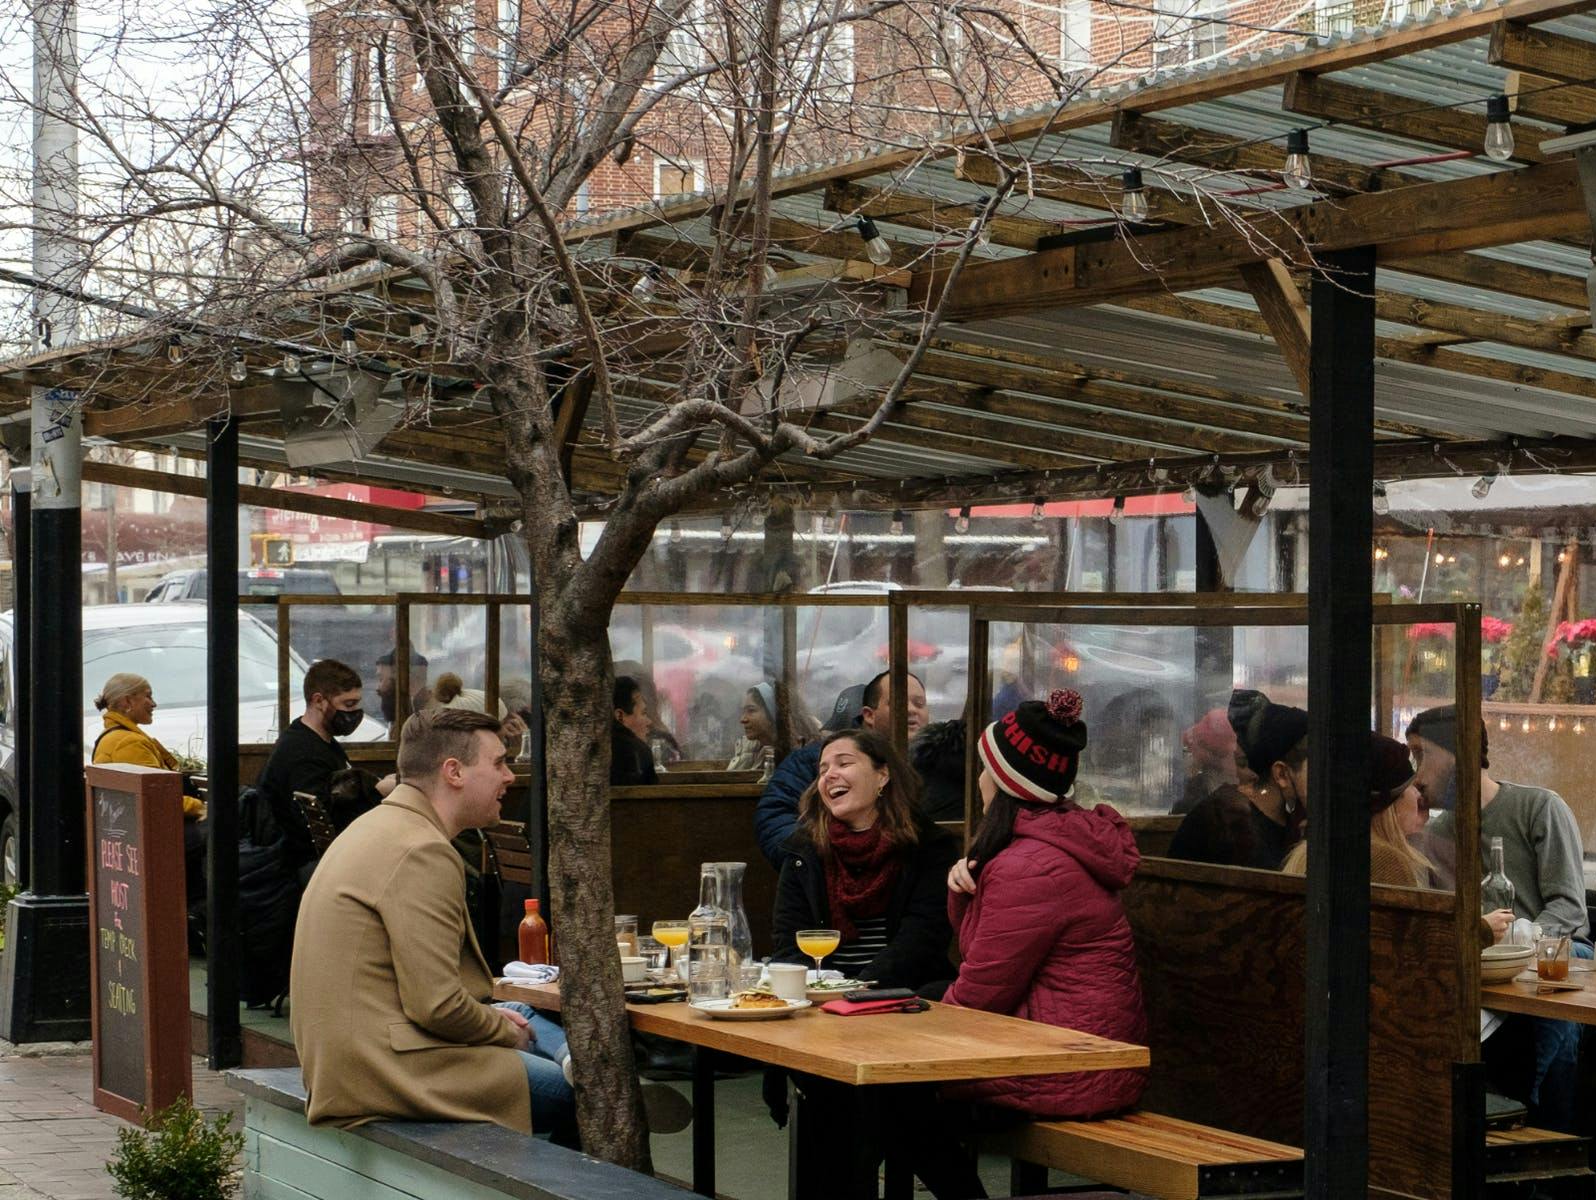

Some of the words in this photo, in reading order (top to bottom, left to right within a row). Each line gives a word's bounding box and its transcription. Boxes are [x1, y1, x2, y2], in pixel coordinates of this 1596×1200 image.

[115, 551, 169, 562] AVERN
[1001, 711, 1069, 774] PHISH
[101, 839, 124, 871] PLEASE
[126, 844, 140, 876] SEE
